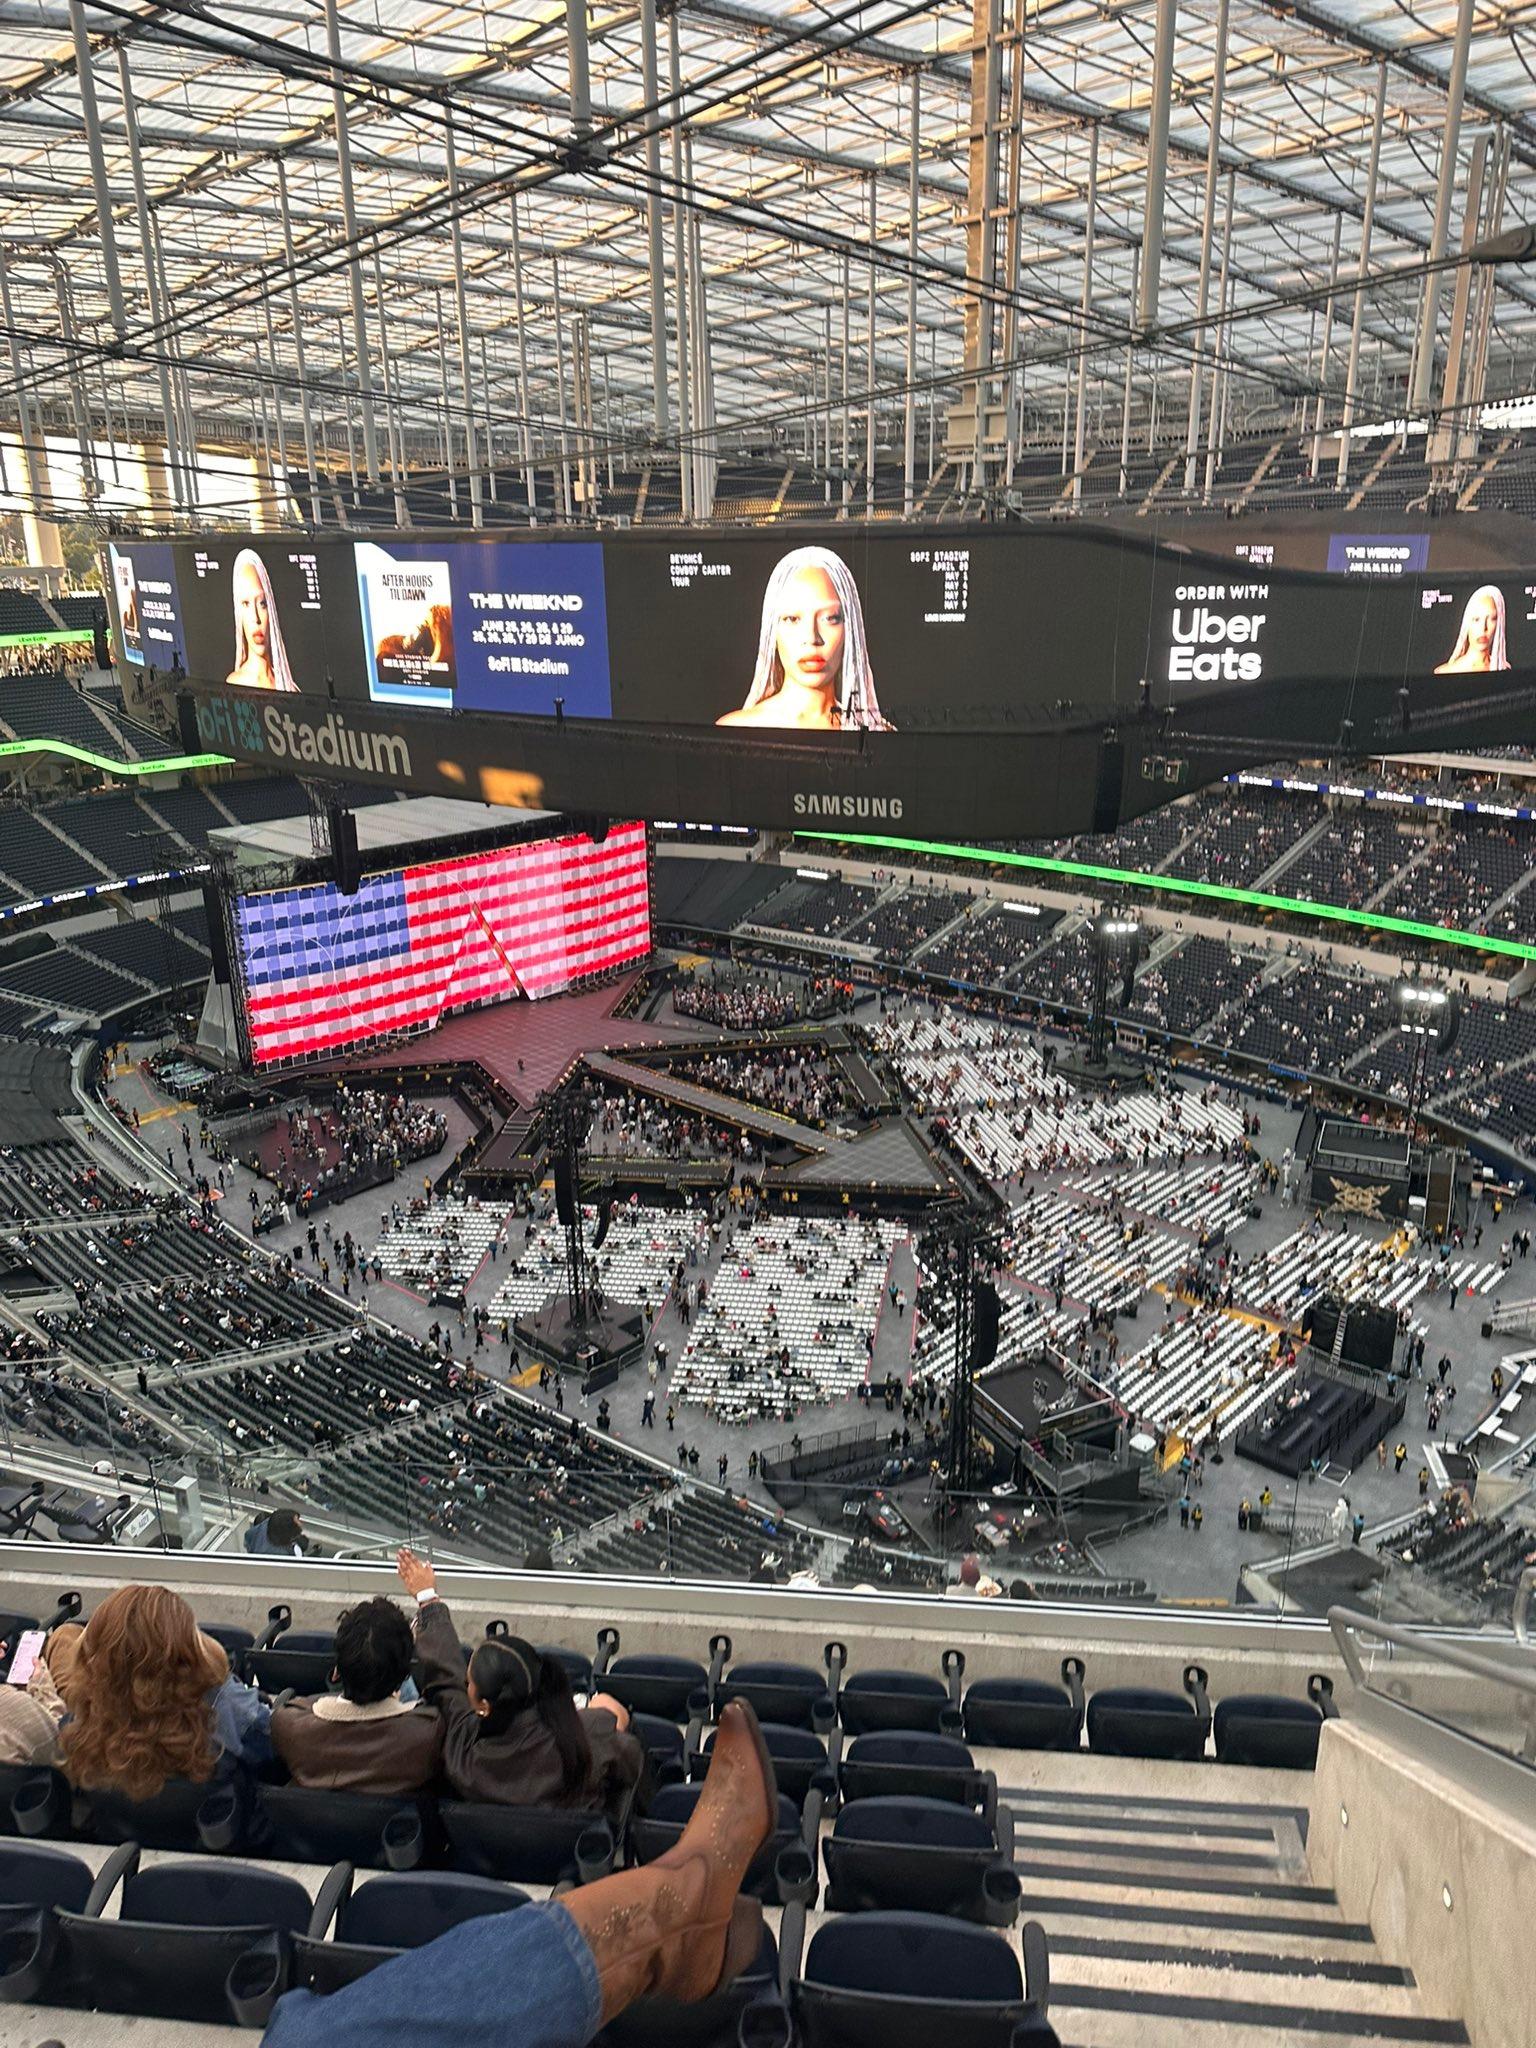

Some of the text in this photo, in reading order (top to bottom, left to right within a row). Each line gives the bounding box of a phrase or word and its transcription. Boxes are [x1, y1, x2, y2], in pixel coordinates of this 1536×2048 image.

[934, 551, 970, 561] STADIUM
[1345, 547, 1366, 558] THE
[670, 565, 732, 576] COWBOY CARTER
[945, 571, 960, 581] MAY
[382, 574, 433, 588] AFTER HOURS
[670, 576, 690, 587] TOUR
[944, 581, 959, 590] MAY
[390, 588, 426, 600] TIL DAWN
[944, 590, 959, 600] MAY
[1175, 584, 1269, 600] ORDER WITH
[469, 593, 583, 611] THE WEEKND
[944, 600, 959, 610] MAY
[482, 620, 504, 632] JUNE
[1172, 607, 1266, 644] Uber
[538, 634, 552, 646] DE
[555, 634, 585, 647] JUNIO
[488, 656, 569, 675] SoFi Stadium
[1168, 646, 1262, 681] Eats
[196, 698, 412, 777] oFi Stadium
[793, 793, 903, 819] SAMSUNG
